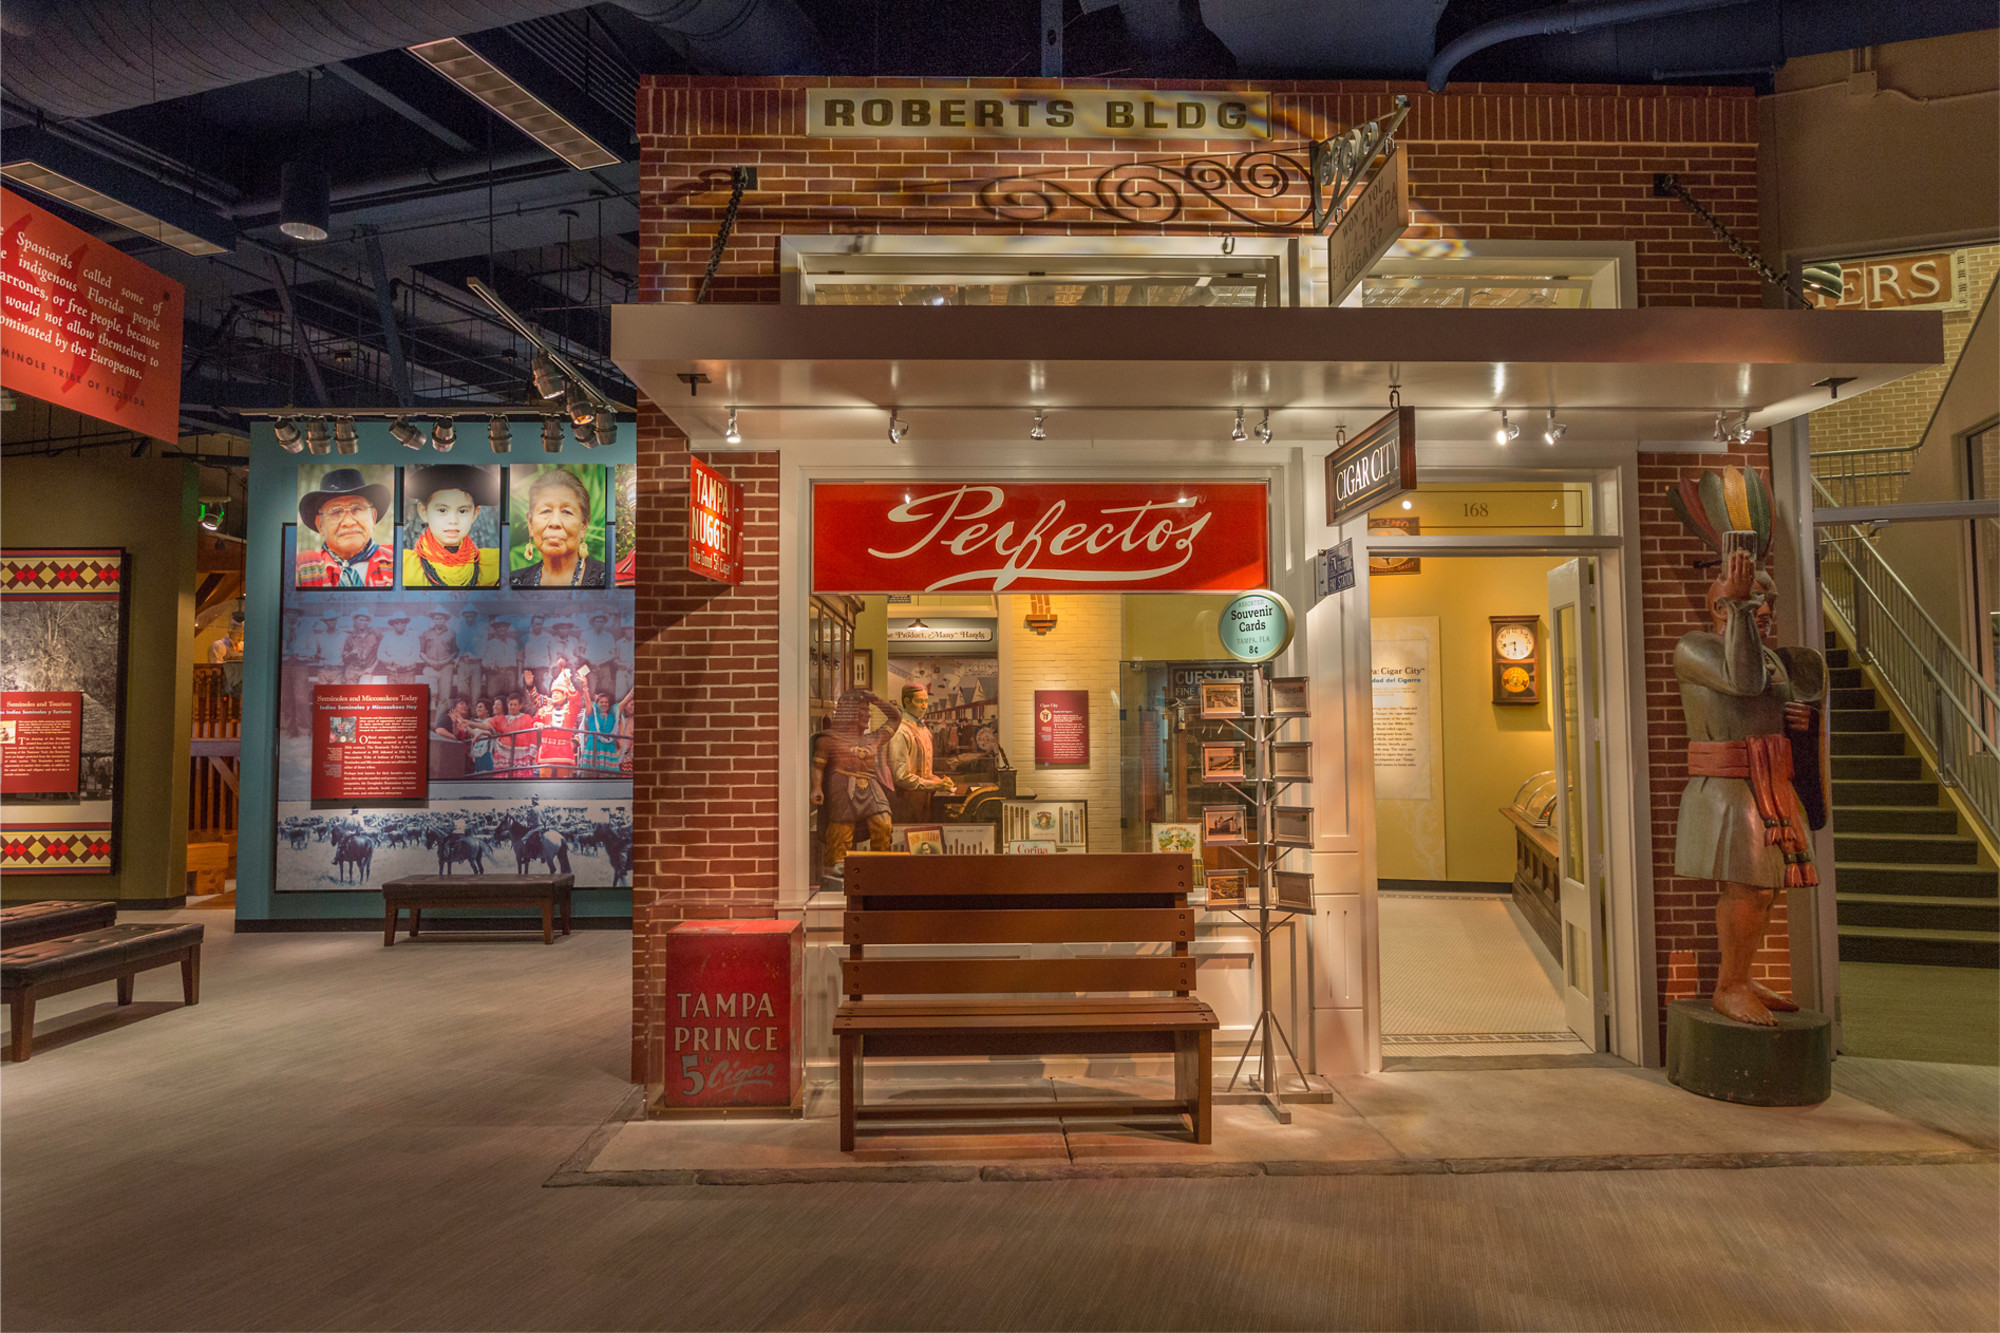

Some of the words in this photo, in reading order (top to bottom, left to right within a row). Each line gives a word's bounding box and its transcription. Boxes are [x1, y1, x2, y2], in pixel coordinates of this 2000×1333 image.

[823, 99, 1075, 128] ROBERTS
[1105, 101, 1248, 130] BLDG
[1342, 200, 1366, 238] WON'T
[1367, 176, 1384, 204] YOU
[1332, 181, 1398, 281] HAV-A-TAMPA
[16, 231, 73, 270] Spaniards
[83, 268, 112, 289] called
[121, 287, 145, 305] some
[152, 302, 164, 316] of
[1344, 228, 1383, 283] CIGAR?
[18, 254, 78, 293] indigenous
[87, 286, 125, 314] Florida
[132, 312, 161, 332] people
[1816, 261, 1941, 307] ERS
[5, 295, 41, 318] would
[44, 311, 63, 327] not
[66, 320, 95, 341] allow
[98, 332, 147, 363] themselves
[149, 355, 159, 368] to
[53, 295, 66, 307] or
[65, 298, 88, 317] free
[89, 312, 124, 335] people,
[126, 323, 161, 350] because
[55, 333, 69, 353] by
[70, 341, 87, 358] the
[89, 346, 143, 380] Europeans.
[53, 366, 82, 385] TRIBE
[88, 379, 101, 391] OF
[105, 386, 146, 407] FLORIDA
[1336, 455, 1370, 502] CIGAR
[1371, 435, 1400, 482] CITY
[696, 468, 729, 519] TAMPA
[1463, 502, 1489, 518] 168
[691, 506, 732, 555] NUGGET
[868, 484, 1212, 593] Perfectos
[1369, 519, 1409, 530] PTIMO
[1230, 604, 1273, 621] Souvenir
[1238, 619, 1266, 633] Cards
[1175, 670, 1255, 685] CUESTA-RE
[1175, 687, 1196, 696] FINE
[1380, 666, 1402, 676] Cigar
[317, 694, 348, 702] Seminoles
[361, 694, 399, 702] Miccosukees
[400, 694, 418, 703] Today
[1017, 843, 1048, 855] Corina
[676, 992, 775, 1018] TAMPA
[674, 1026, 779, 1052] PRINCE
[707, 1059, 776, 1096] Cigar
